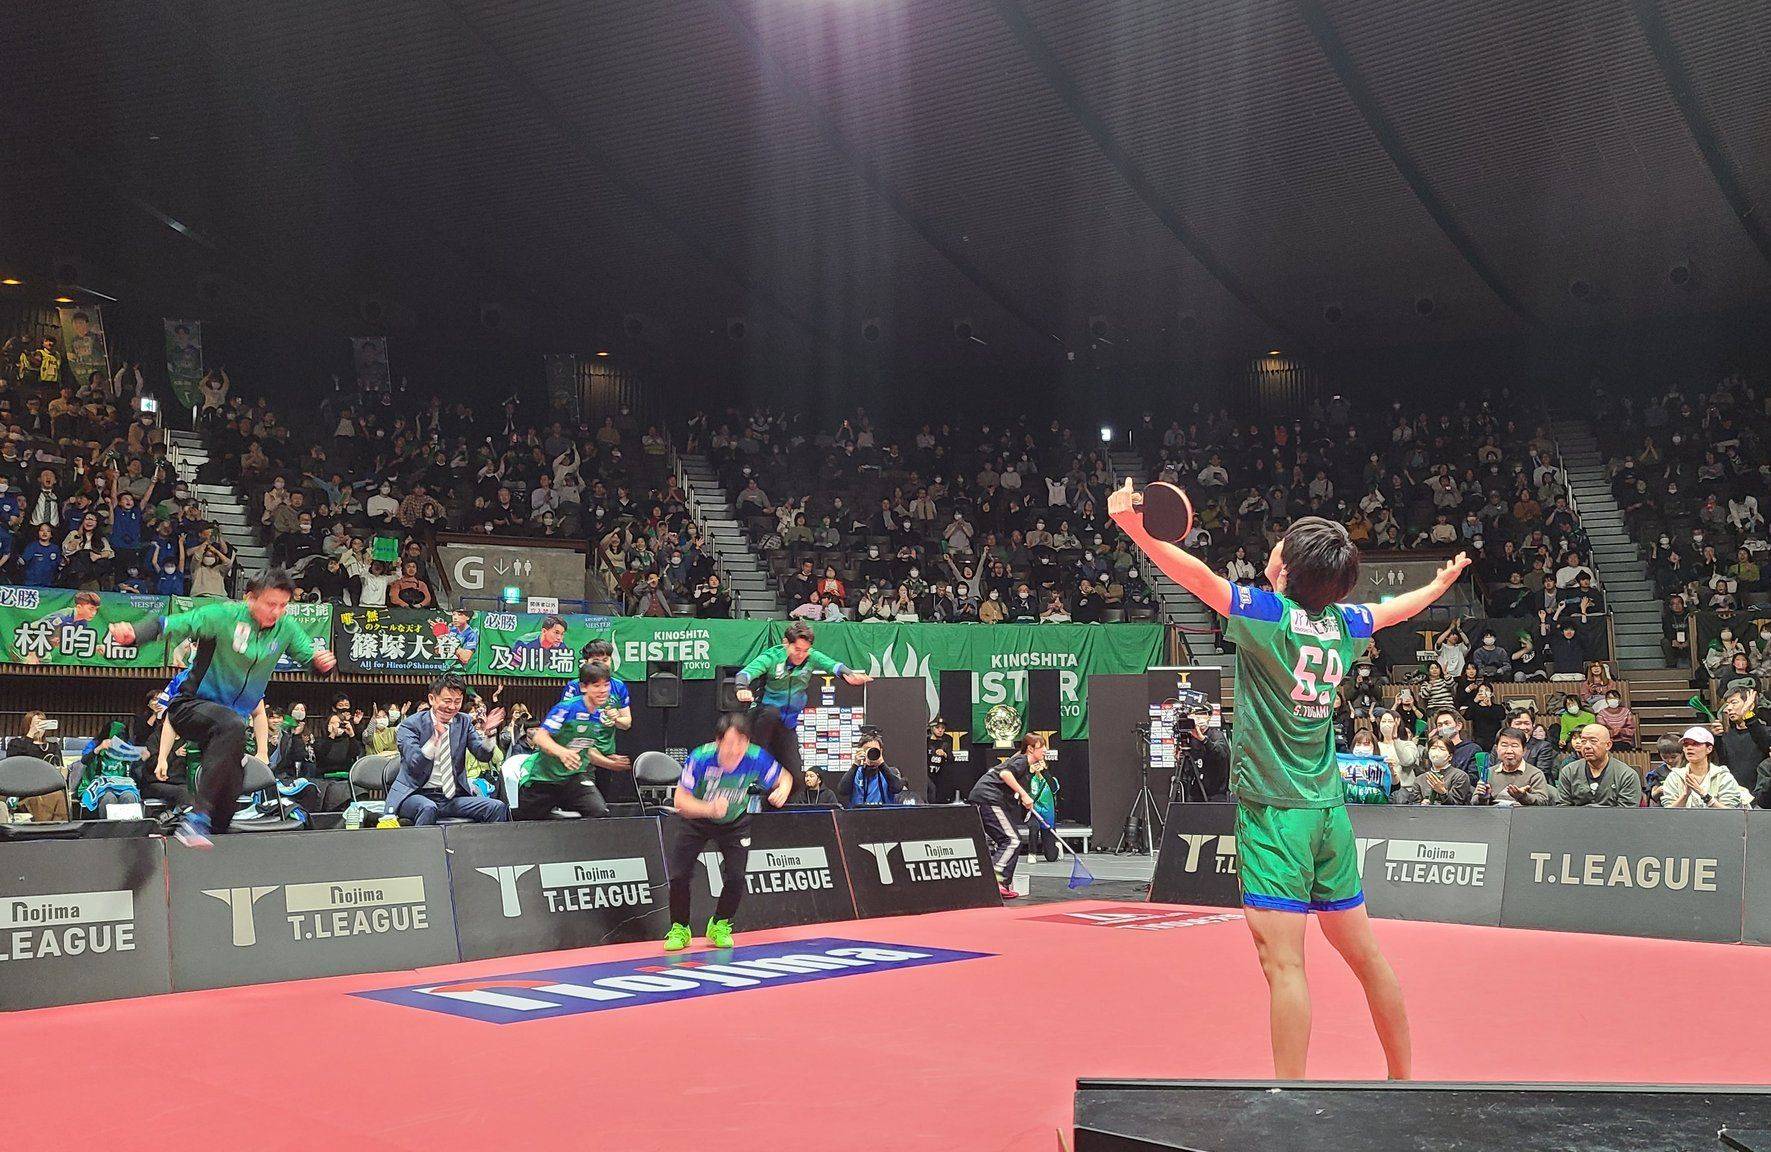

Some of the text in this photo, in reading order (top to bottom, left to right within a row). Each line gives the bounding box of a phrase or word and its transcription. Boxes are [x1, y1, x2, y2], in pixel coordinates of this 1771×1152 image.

[454, 556, 485, 590] G
[0, 586, 39, 609] 必勝
[484, 612, 517, 632] 必勝
[654, 630, 710, 641] KINOSHITA
[489, 645, 586, 673] 及川瑞
[684, 661, 711, 670] TOKYO
[991, 653, 1079, 668] KINOSHITA
[971, 670, 1079, 703] ISTR
[745, 869, 834, 894] T.LEAGUE
[905, 859, 982, 882] T.LEAGUE
[1385, 862, 1486, 887] T.LEAGUE
[1530, 852, 1718, 892] T.LEAGUE
[543, 883, 653, 913] T.LEAGUE
[12, 901, 80, 922] nojima
[287, 905, 429, 941] T.LEAGUE
